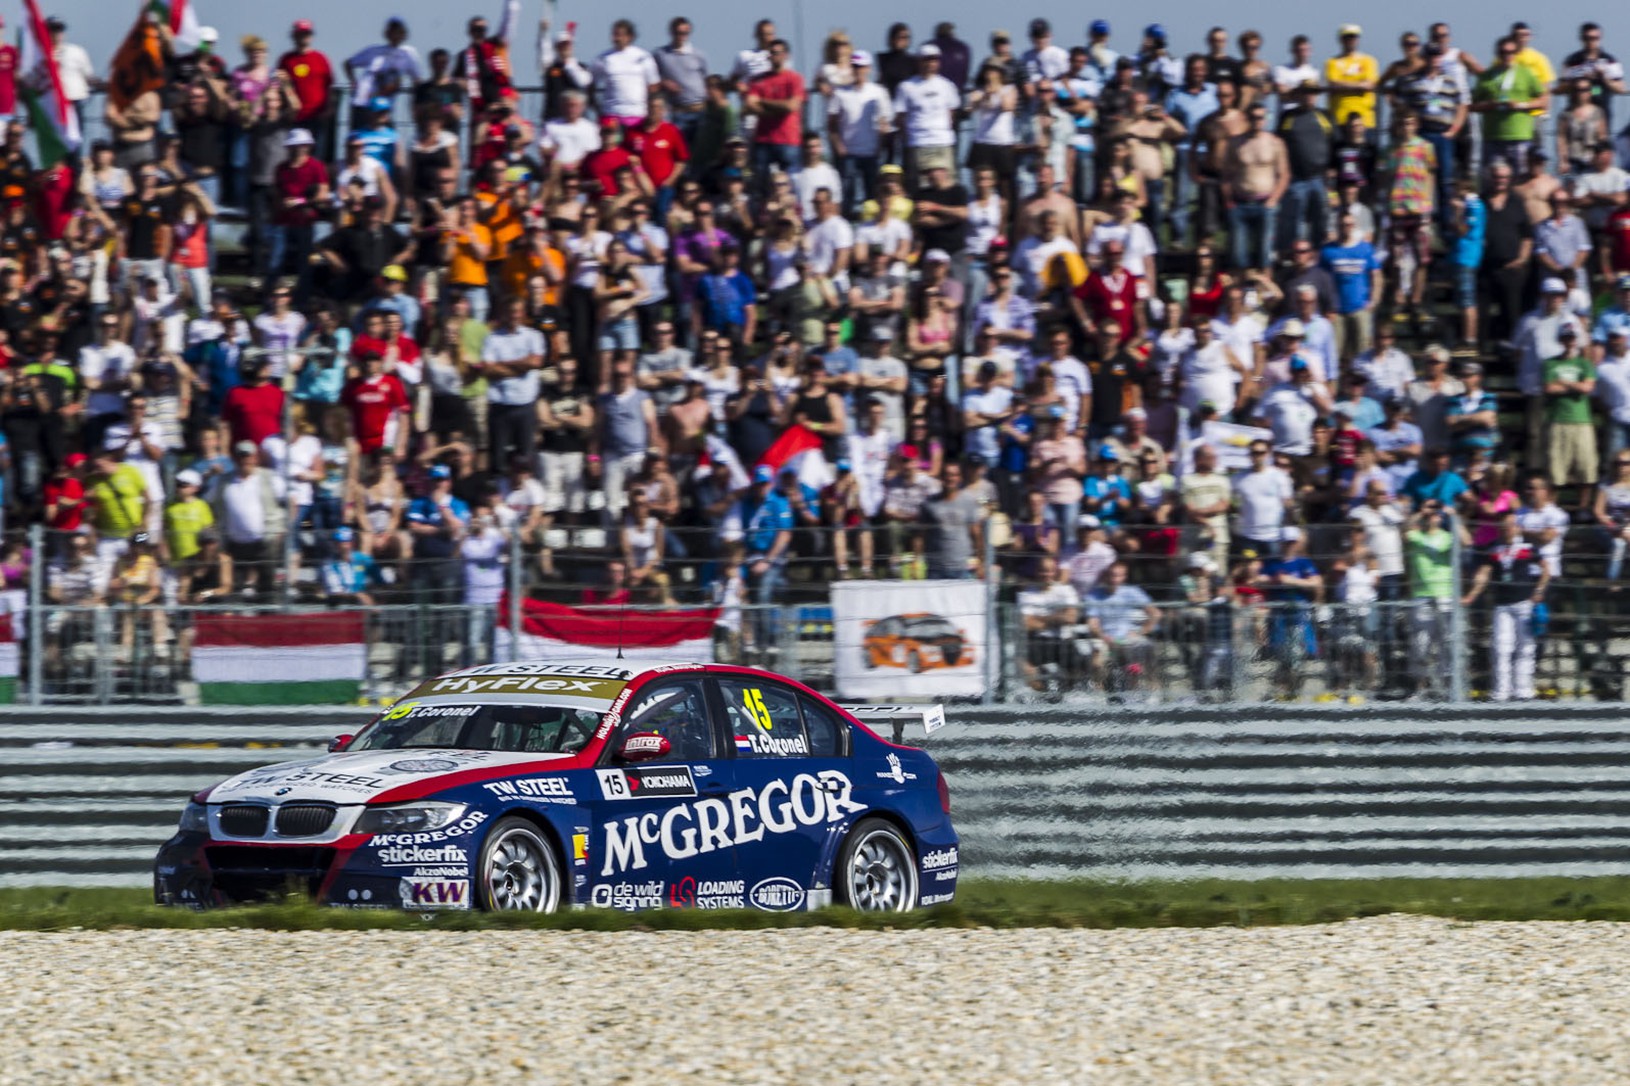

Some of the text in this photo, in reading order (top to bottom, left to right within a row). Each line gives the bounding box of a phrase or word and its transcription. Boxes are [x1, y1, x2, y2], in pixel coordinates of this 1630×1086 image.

[508, 664, 620, 677] STEEL
[432, 676, 603, 693] HyFlex
[743, 688, 773, 730] 15
[286, 772, 385, 789] STEEL
[482, 777, 574, 796] TW STEEL
[604, 774, 692, 795] 15 YOKOHAMA
[368, 811, 489, 847] McGREGOR
[601, 770, 868, 876] McGREGOR
[378, 845, 468, 862] stickerfix
[413, 867, 469, 877] AkzoNobel
[411, 882, 466, 903] KW
[613, 880, 665, 896] de wild
[696, 879, 745, 895] LOADING
[696, 895, 745, 909] SYSTEMS
